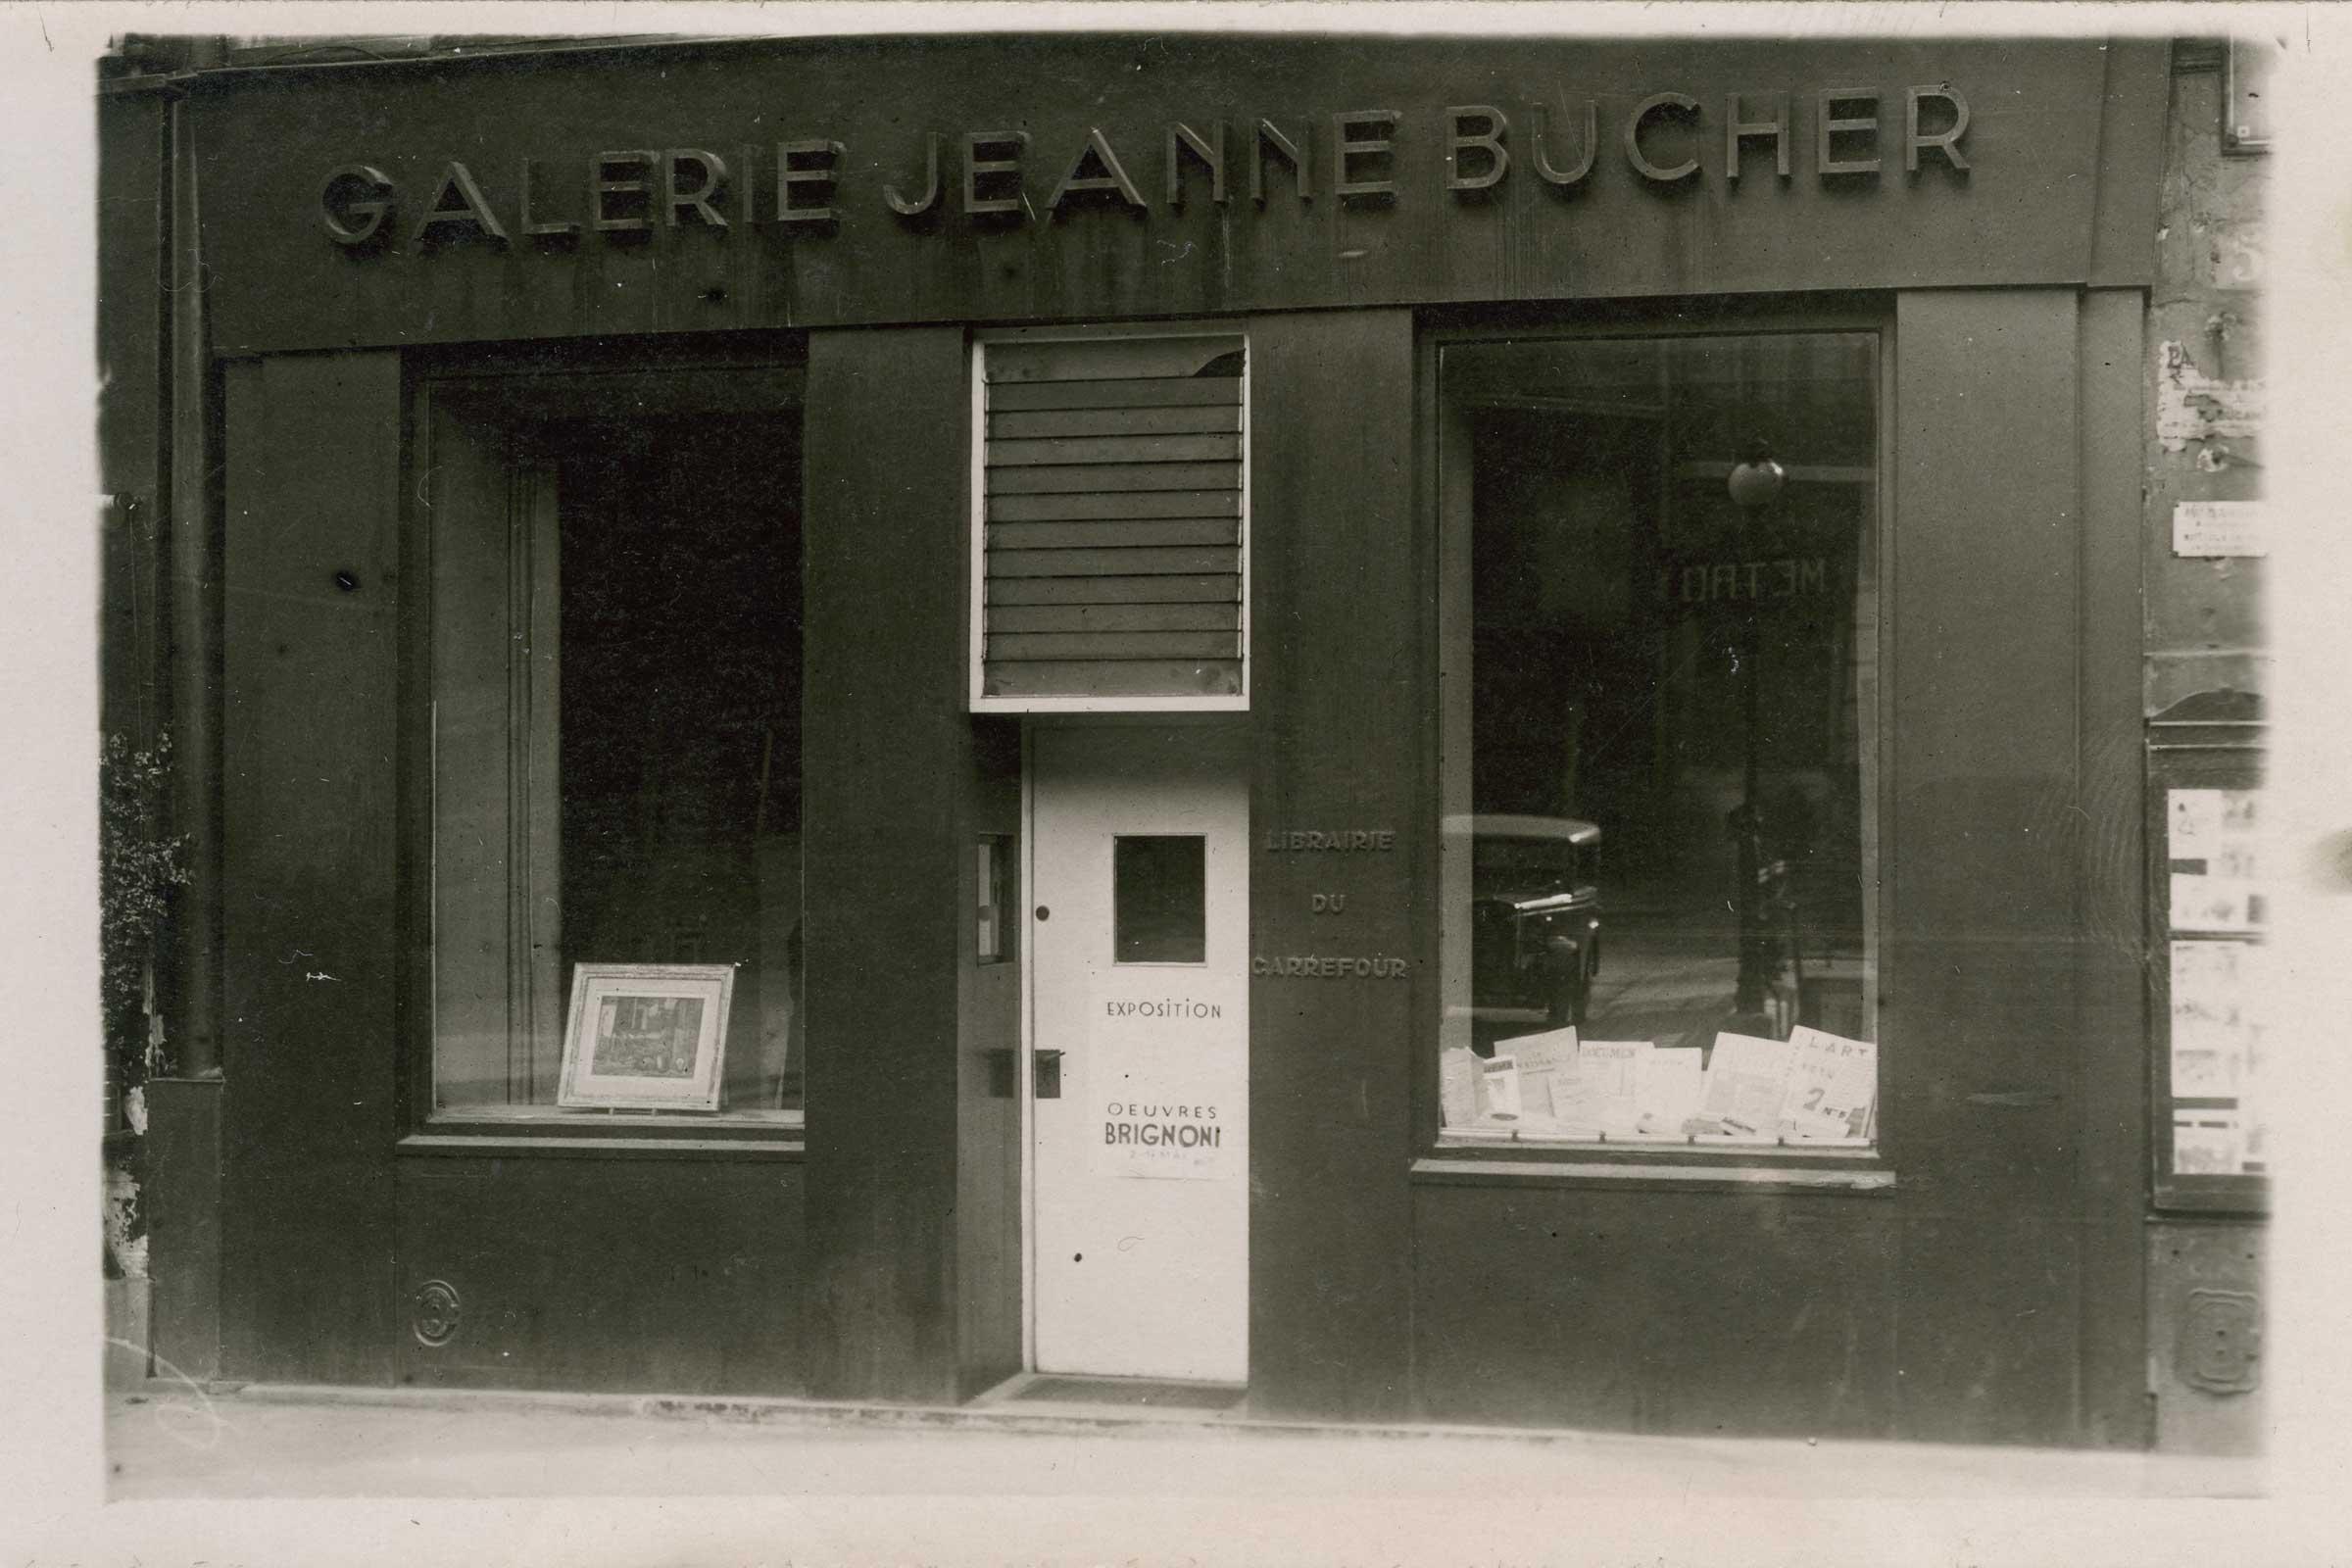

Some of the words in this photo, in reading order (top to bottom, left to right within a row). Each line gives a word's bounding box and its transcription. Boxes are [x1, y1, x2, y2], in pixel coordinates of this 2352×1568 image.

[319, 137, 846, 245] GALERIE
[884, 110, 1401, 217] JEANNE
[1446, 84, 1971, 190] BUCHER
[1268, 830, 1394, 852] LIBRAIRIE
[1312, 893, 1346, 912] DU
[1252, 956, 1406, 978] CARREFOUR
[1107, 1102, 1216, 1119] OEUVRES
[1105, 1122, 1220, 1148] BRIGNONI
